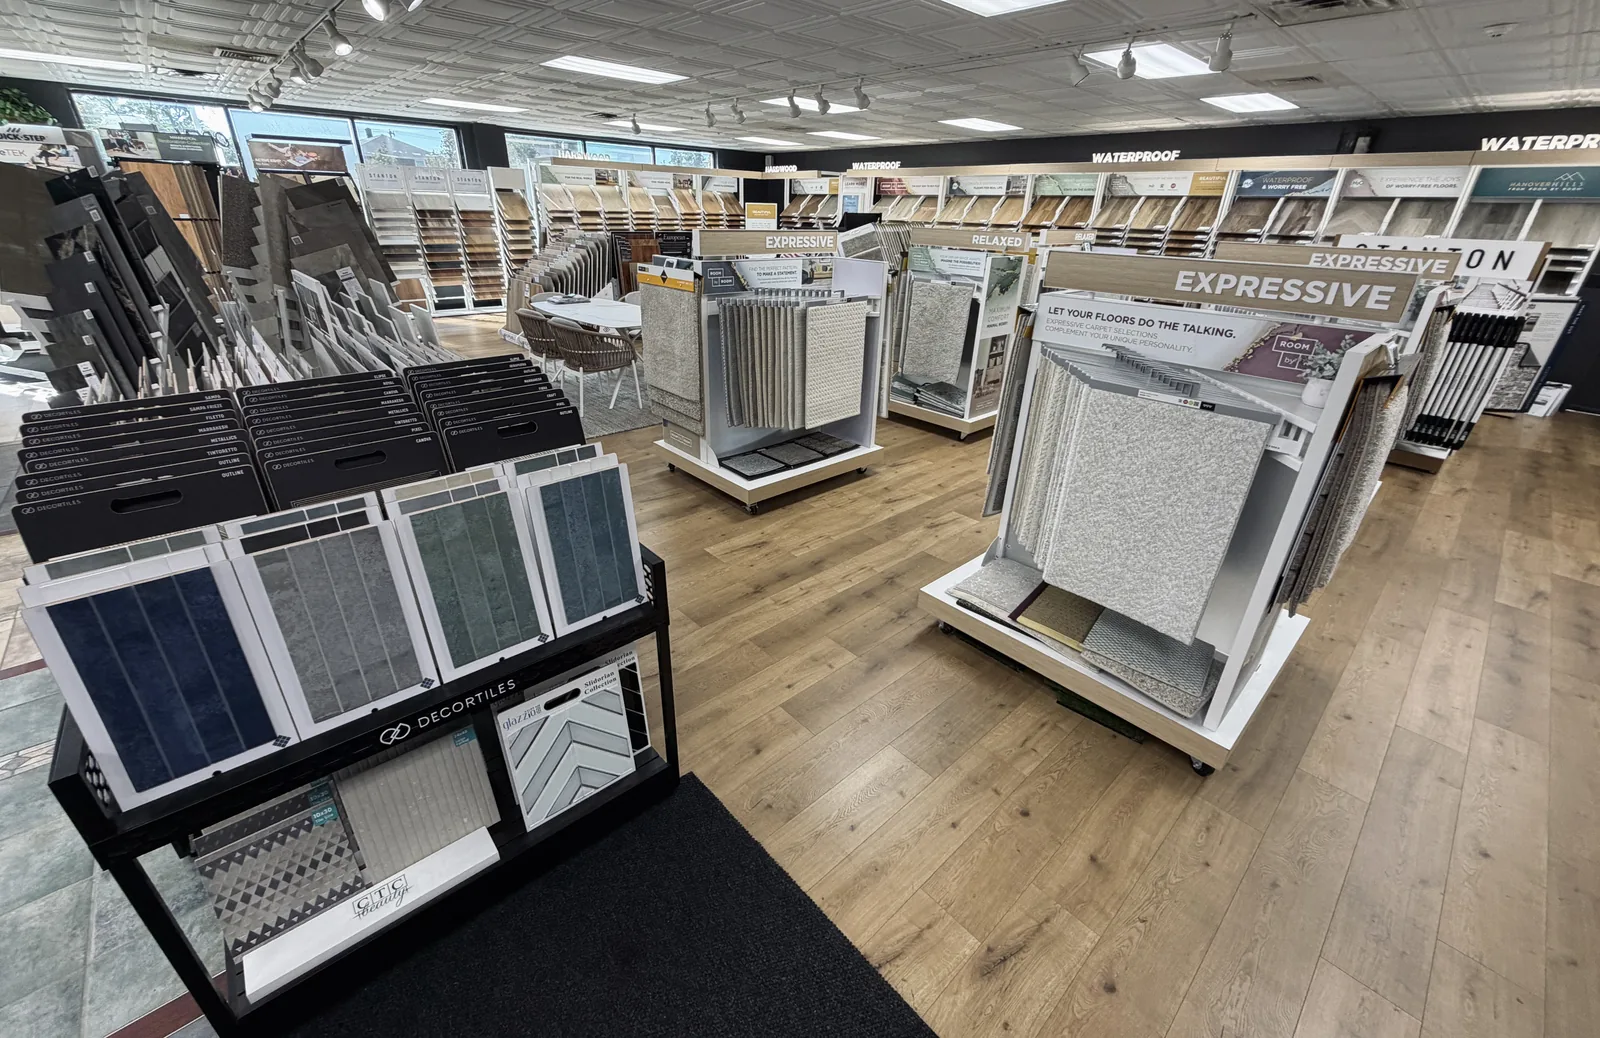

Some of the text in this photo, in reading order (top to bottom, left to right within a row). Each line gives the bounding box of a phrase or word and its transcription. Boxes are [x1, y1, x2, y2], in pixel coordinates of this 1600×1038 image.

[1092, 150, 1180, 164] WATERPROOF
[852, 161, 901, 170] WATERPROOF
[766, 236, 834, 248] EXPRESSIVE
[972, 234, 1022, 246] RELAXED
[1309, 252, 1450, 274] EXPRESSIVE
[1175, 270, 1396, 310] EXPRESSIVE
[1046, 318, 1084, 329] EXPRESSIVE
[1085, 323, 1112, 332] CARPET
[1048, 306, 1236, 339] LET YOUR FLOORS DO THE TALKING.
[1045, 325, 1192, 353] COMPLEMENT YOUR UNIQUE PERSONALITY.
[1280, 341, 1310, 350] ROOM
[1284, 356, 1296, 364] by
[266, 425, 296, 434] DECORTILES
[273, 436, 304, 445] DECORTILES
[40, 446, 80, 457] DECORTILES
[207, 447, 237, 456] TINTORETTO
[274, 447, 306, 456] DECORTILES
[48, 457, 89, 468] DECORTILES
[282, 458, 314, 468] DECORTILES
[40, 472, 83, 483] DECORTILES
[41, 485, 84, 497] DECORTILES
[37, 499, 82, 511] DECORTILES
[605, 650, 633, 664] Slidorian
[617, 656, 635, 667] ection
[584, 671, 614, 688] Slidorian
[584, 678, 617, 694] Collection
[418, 679, 516, 728] DECORTILES
